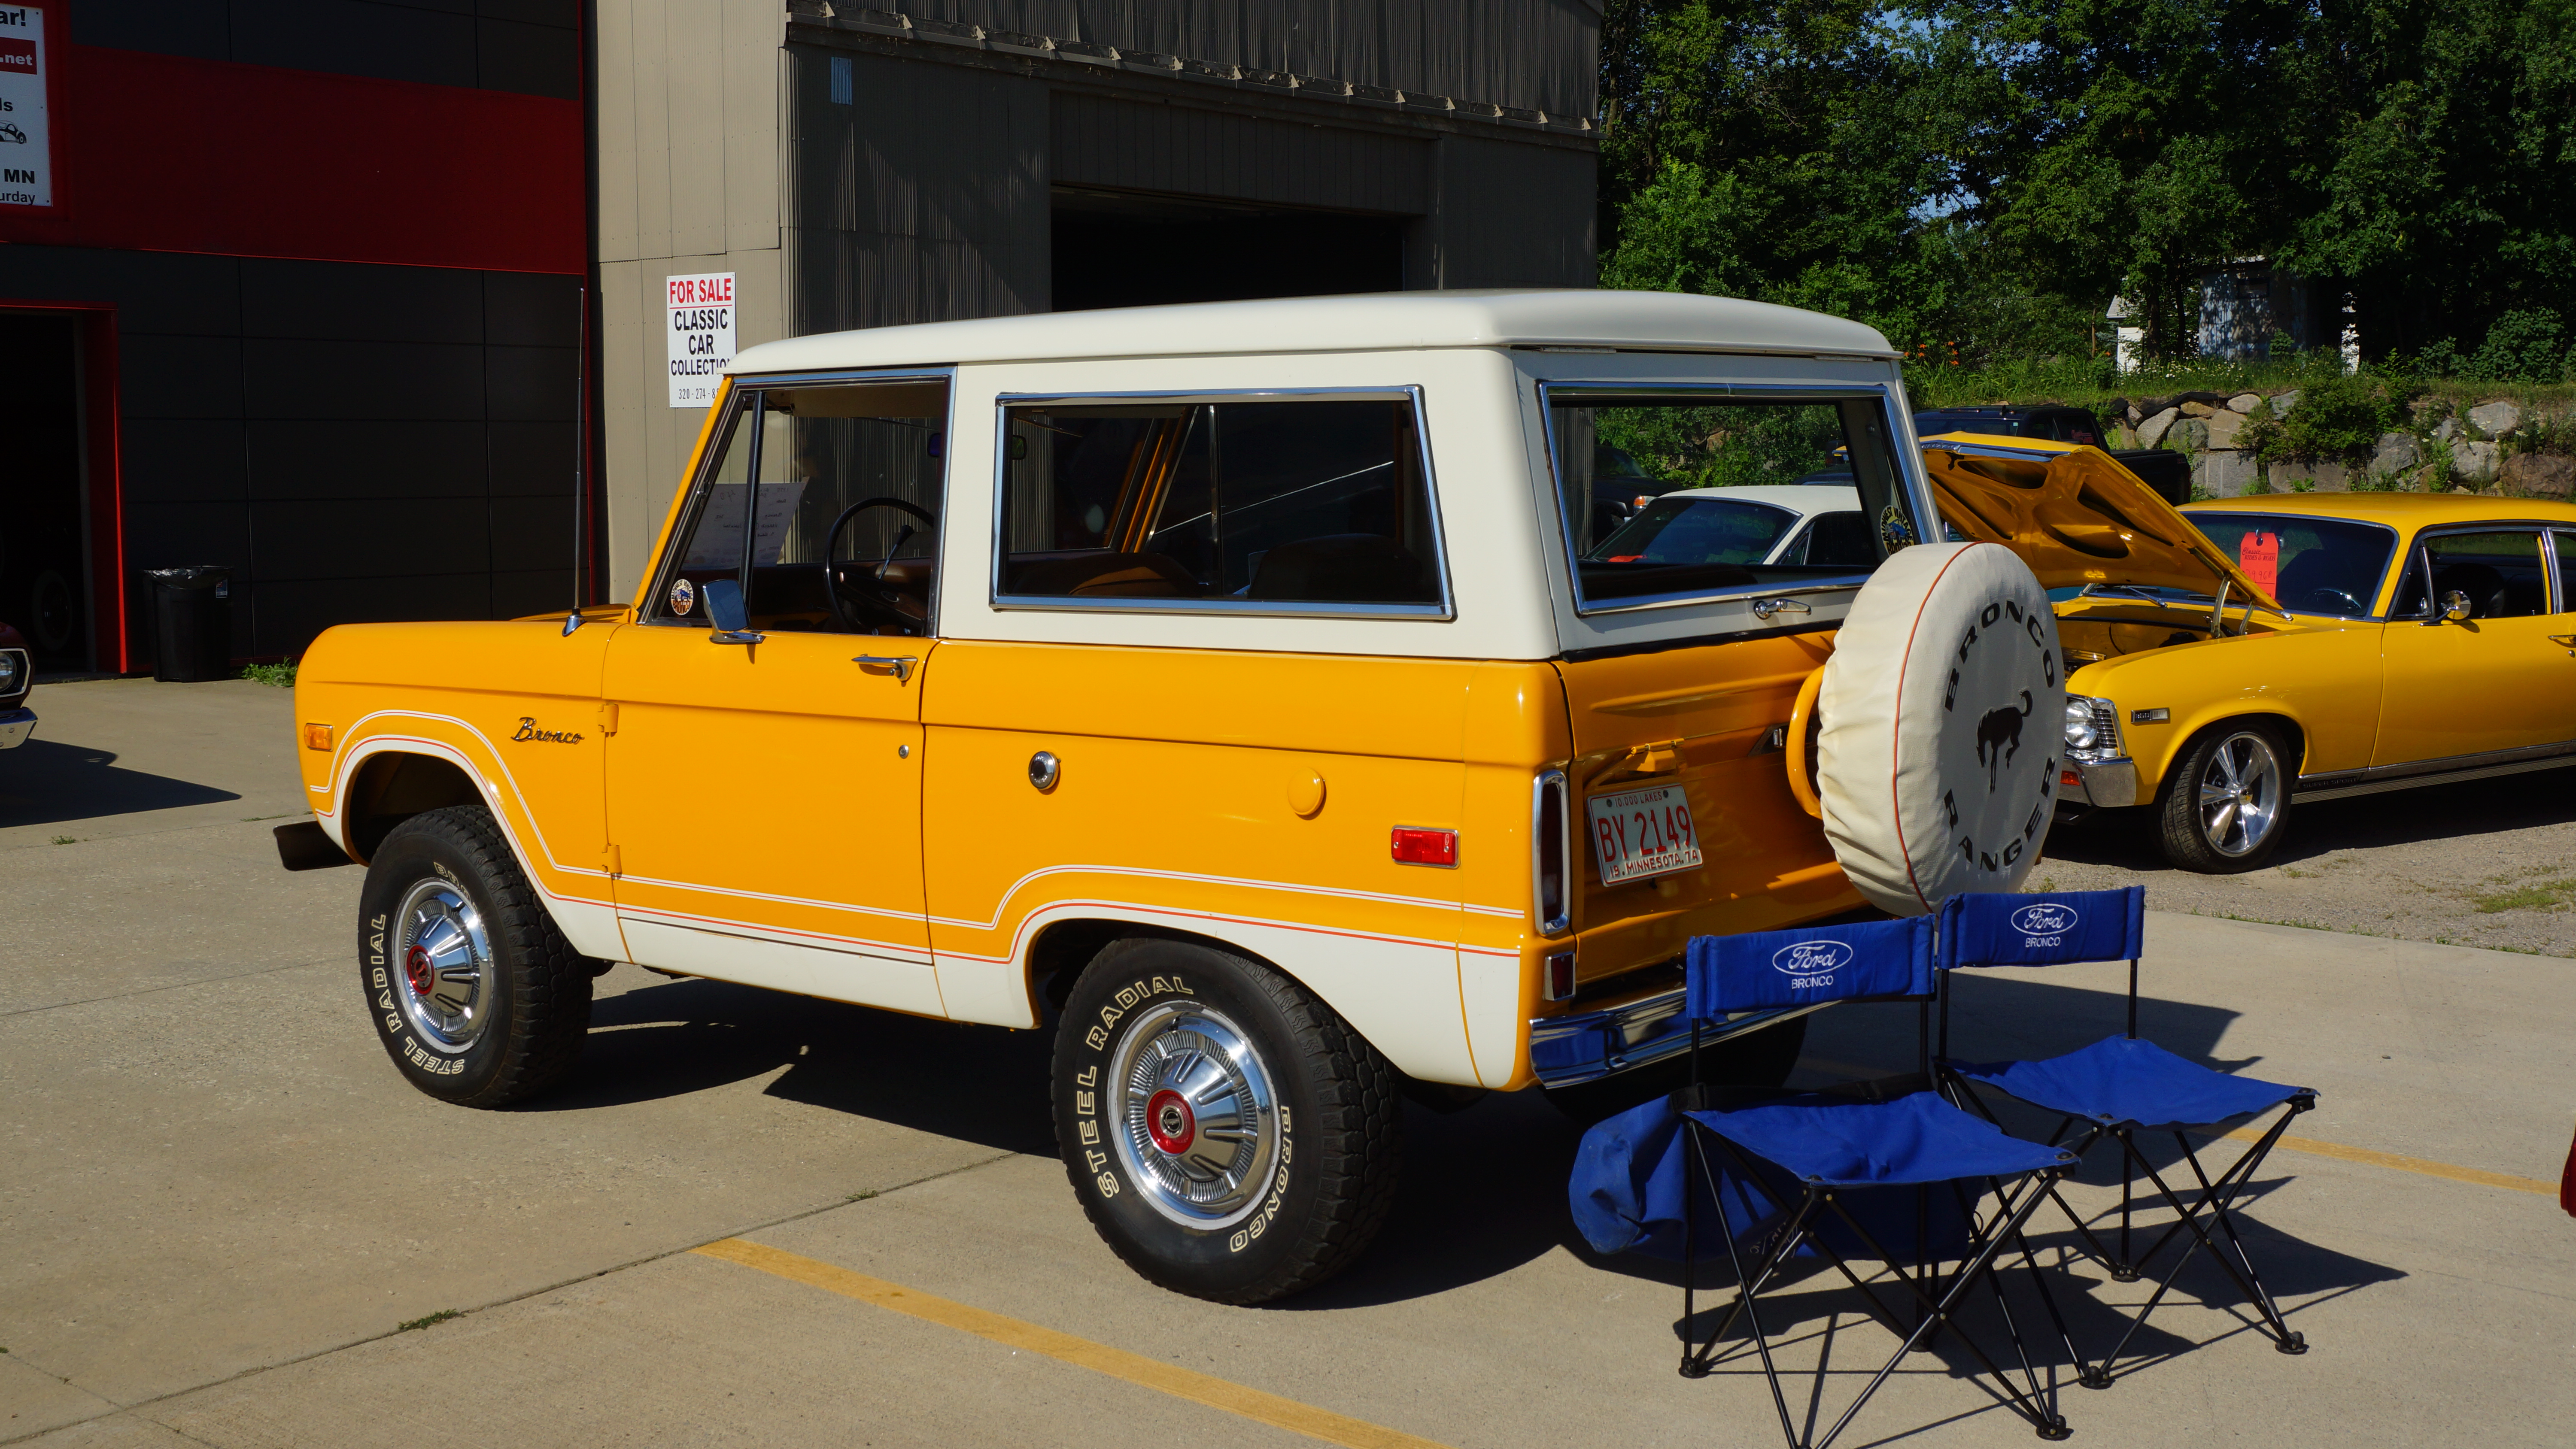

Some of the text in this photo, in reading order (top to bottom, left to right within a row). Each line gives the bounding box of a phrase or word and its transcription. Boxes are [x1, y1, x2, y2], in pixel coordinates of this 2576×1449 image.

[4, 169, 35, 184] MN
[669, 278, 732, 304] FOR SALE
[674, 309, 728, 331] CLASSIC
[688, 334, 714, 355] CAR
[671, 358, 730, 376] COLLECTIO
[1881, 506, 1914, 542] MIDWEST VINTAGE
[2242, 547, 2260, 555] Classic
[671, 580, 693, 600] MIDWEST VINTAGE
[1944, 600, 2055, 712] BRONCO
[510, 717, 585, 745] Bronco
[1640, 791, 1662, 804] LAKES
[1944, 757, 2056, 872] RANGER
[1597, 805, 1691, 863] BY 2149
[1610, 864, 1619, 878] 19
[1625, 852, 1682, 874] MINNESOTA
[2024, 908, 2065, 929] Ford
[2025, 937, 2060, 948] BRONCO
[1788, 945, 1837, 970] Ford
[371, 914, 465, 1075] STEEL RADIAL
[1792, 975, 1833, 989] BRONCO
[1077, 976, 1194, 1199] STEEL RADIAL
[1230, 1106, 1291, 1252] BRONCO
